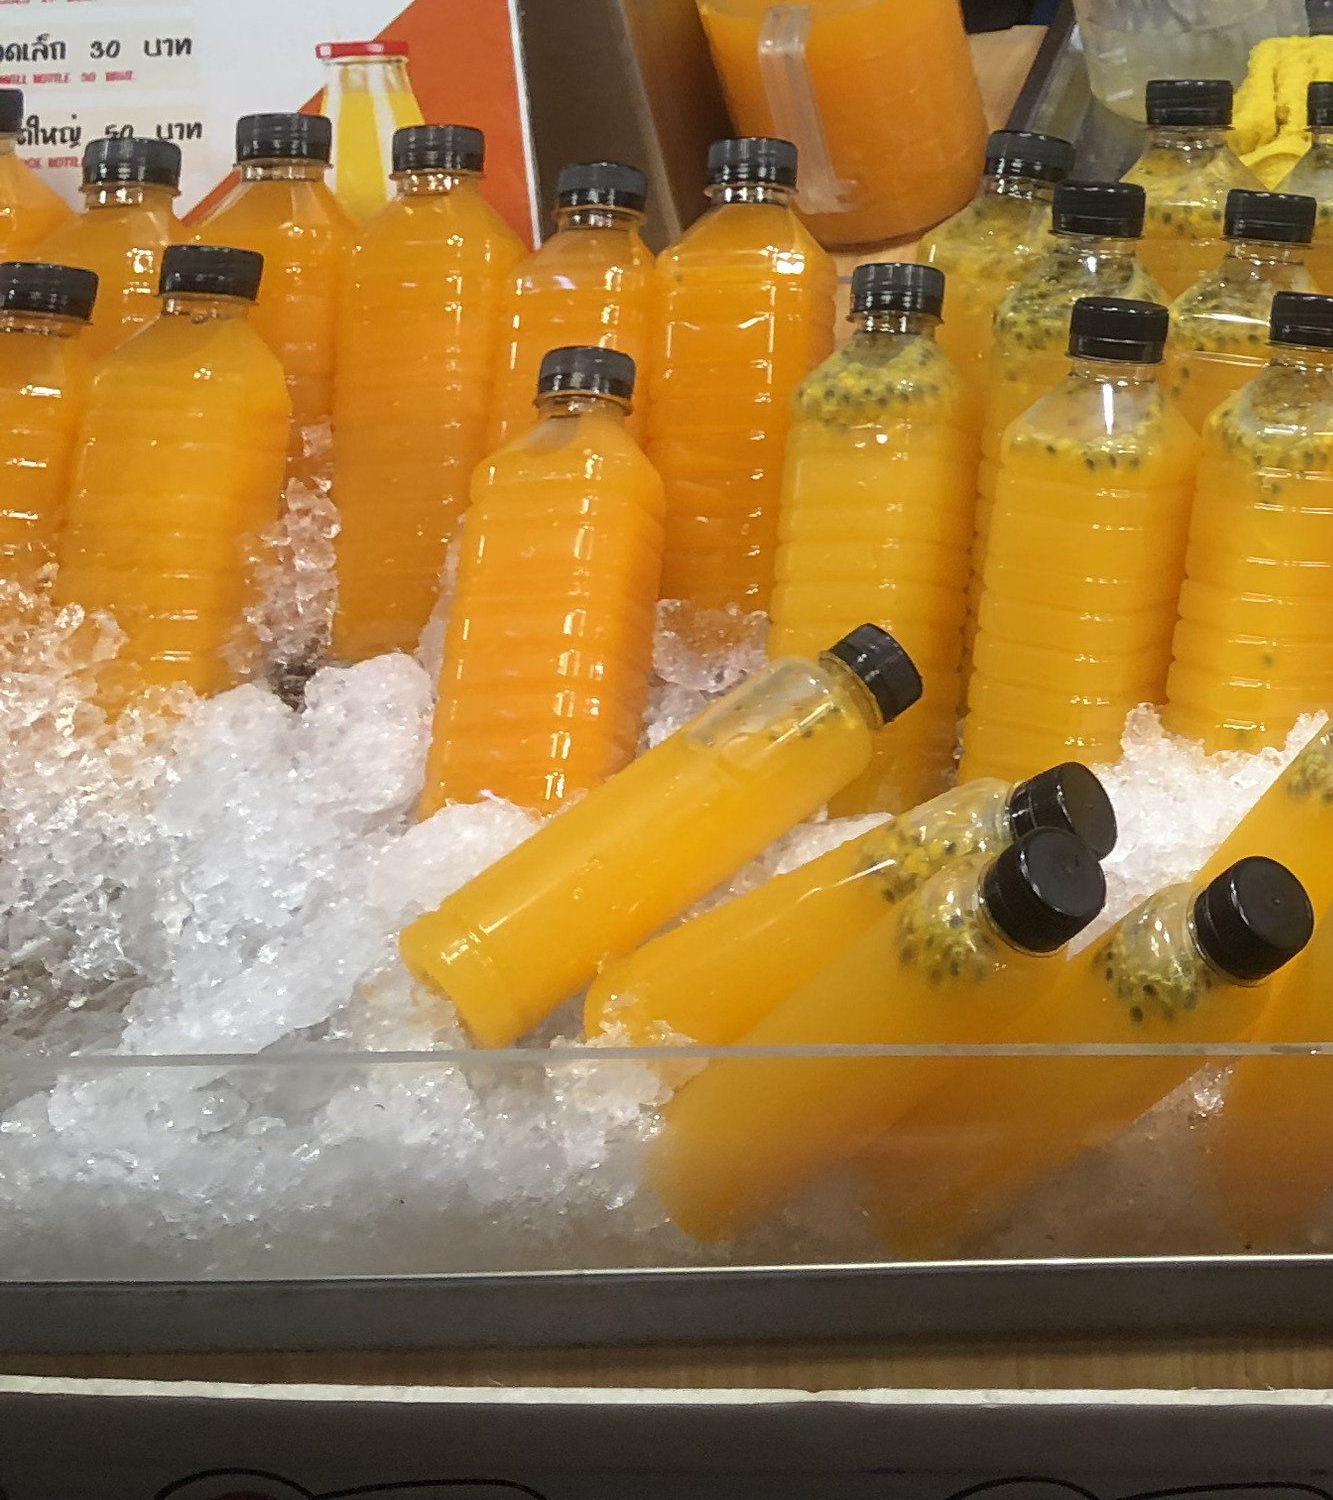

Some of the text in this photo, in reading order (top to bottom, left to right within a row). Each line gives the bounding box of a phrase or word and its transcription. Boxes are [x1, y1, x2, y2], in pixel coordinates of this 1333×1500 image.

[90, 39, 121, 59] 30
[143, 37, 192, 57] บาท
[155, 122, 203, 140] บาท
